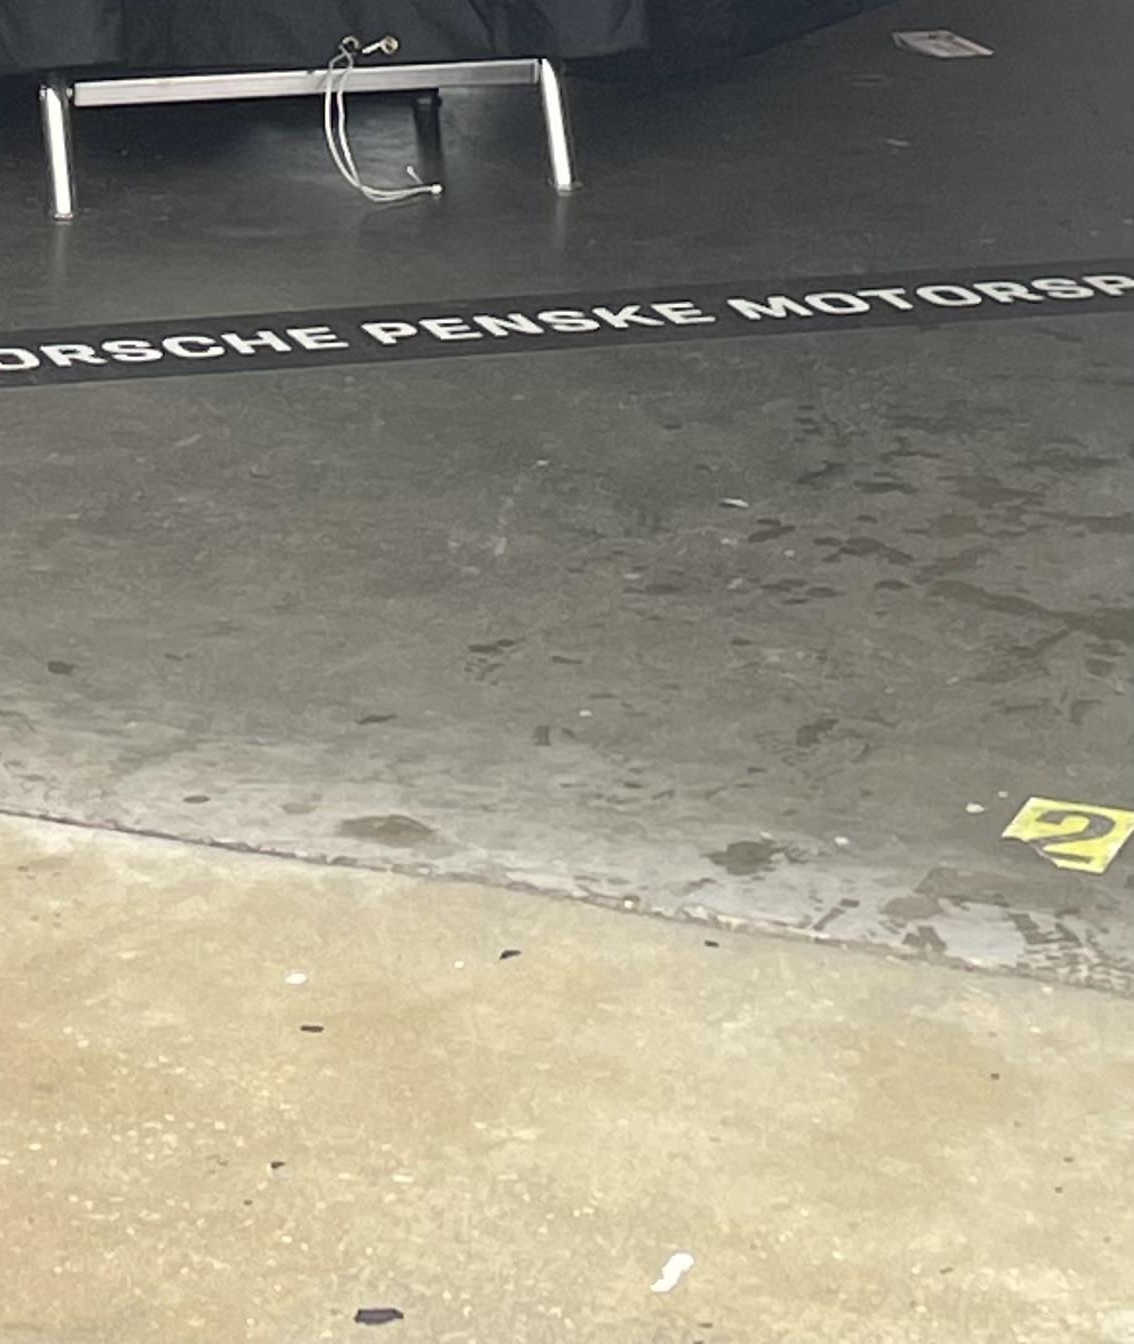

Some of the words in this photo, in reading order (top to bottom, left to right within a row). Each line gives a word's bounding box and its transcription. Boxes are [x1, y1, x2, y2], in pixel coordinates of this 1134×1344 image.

[361, 302, 716, 346] PENSKE
[727, 274, 1134, 321] MOTORSP
[1027, 810, 1116, 864] 2
